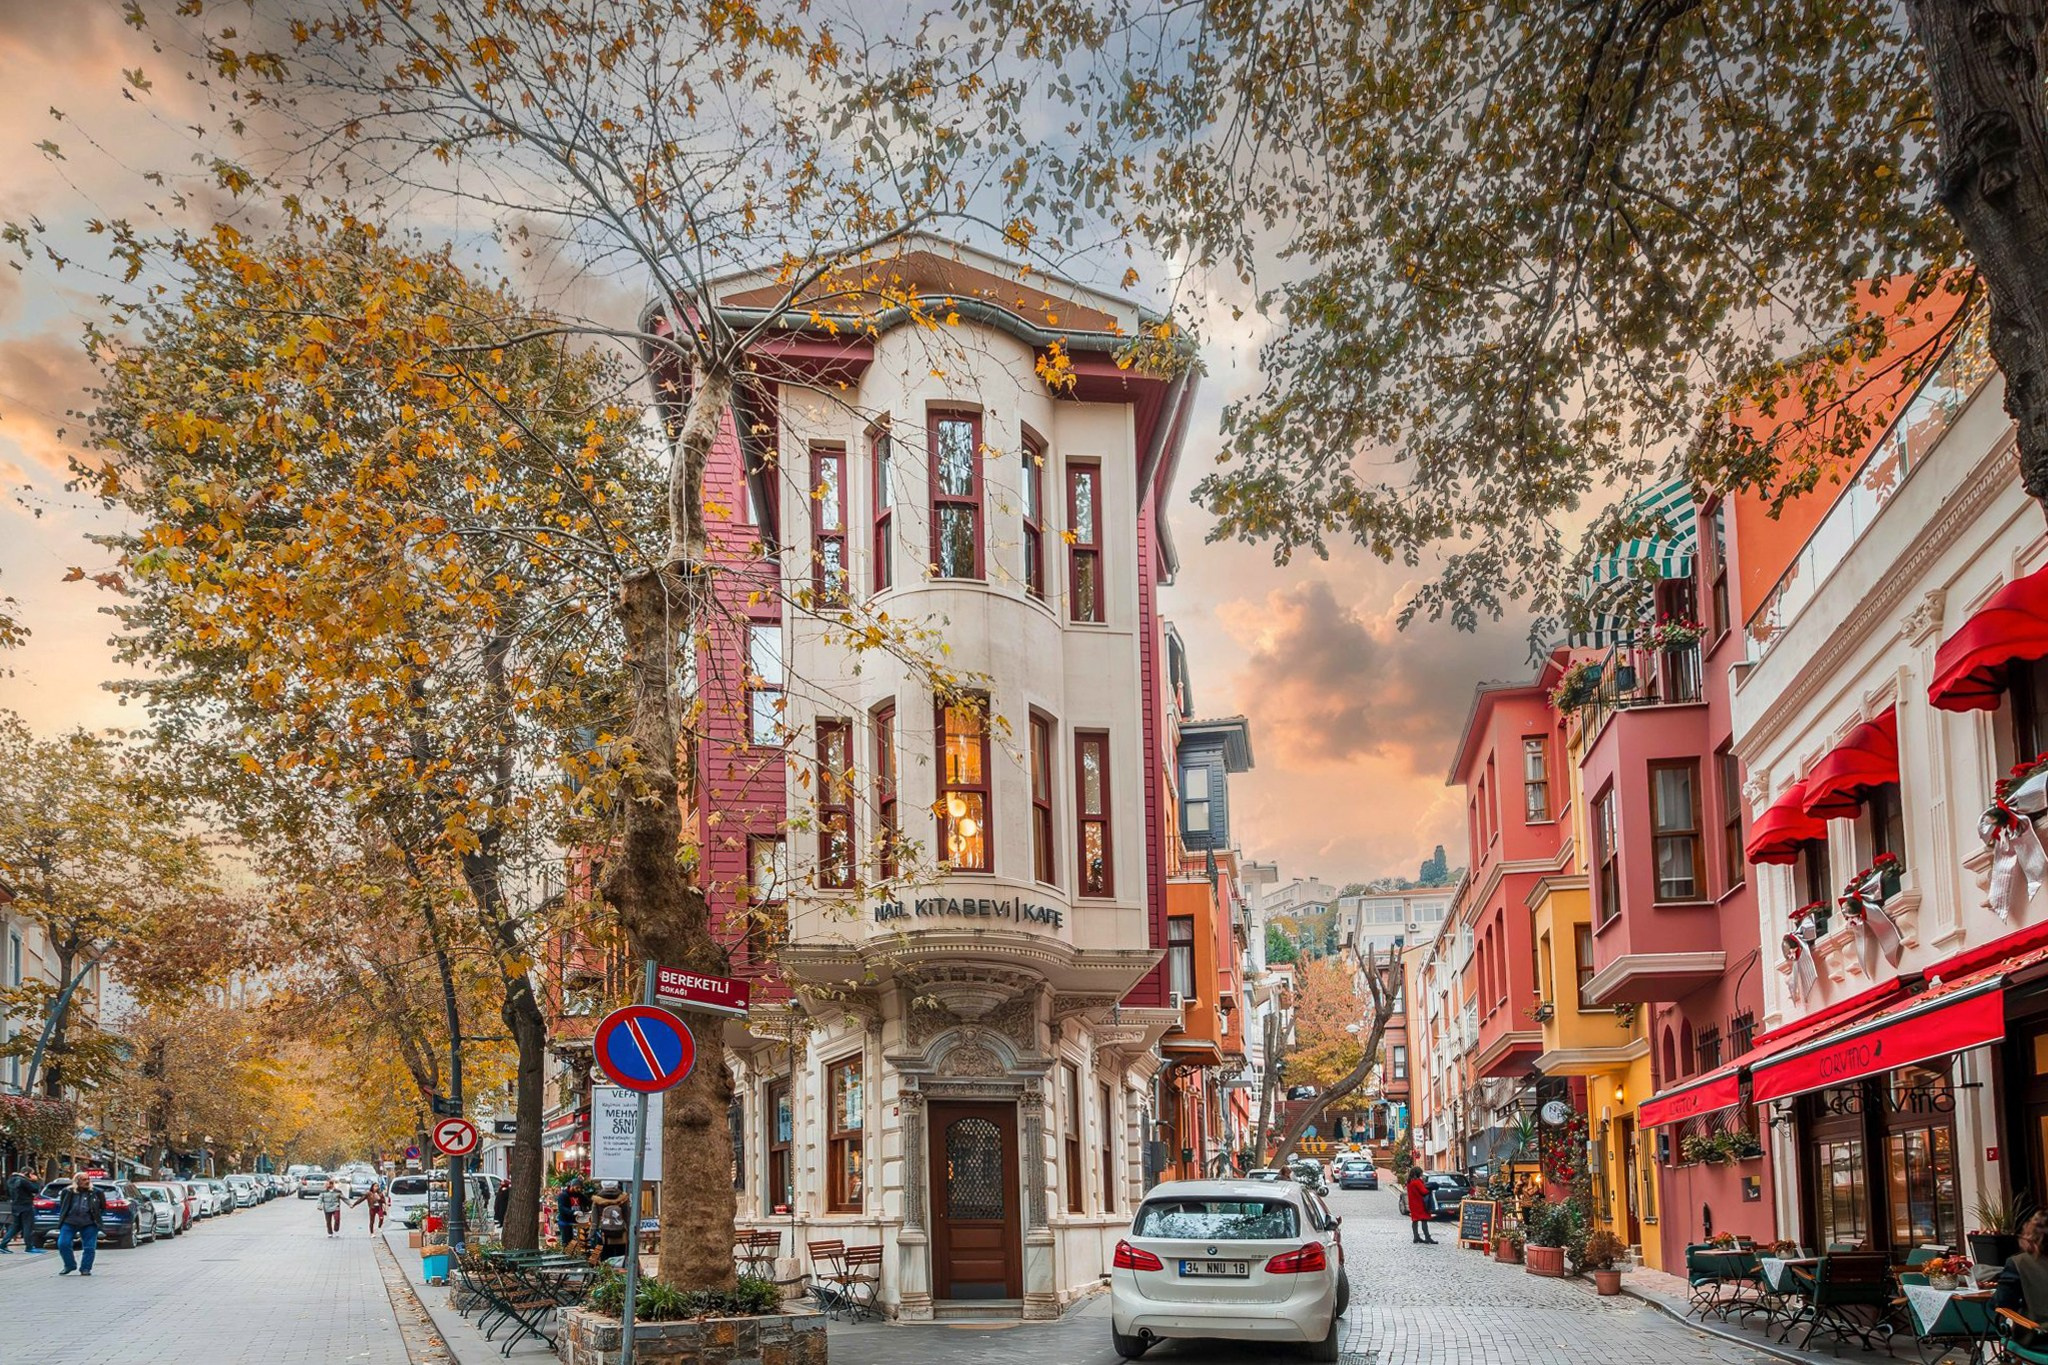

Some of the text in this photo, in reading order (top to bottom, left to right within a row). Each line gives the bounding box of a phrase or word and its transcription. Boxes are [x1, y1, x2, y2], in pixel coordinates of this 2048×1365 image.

[915, 897, 1010, 917] KİTABEVİ
[1023, 903, 1064, 929] KAFE
[660, 971, 730, 994] BEREKETLİ
[660, 985, 688, 996] SOKAĞI
[612, 1090, 636, 1098] VEFA
[606, 1109, 637, 1117] MEHM
[612, 1126, 635, 1134] ONU
[1186, 1262, 1245, 1273] 34 NNU 18
